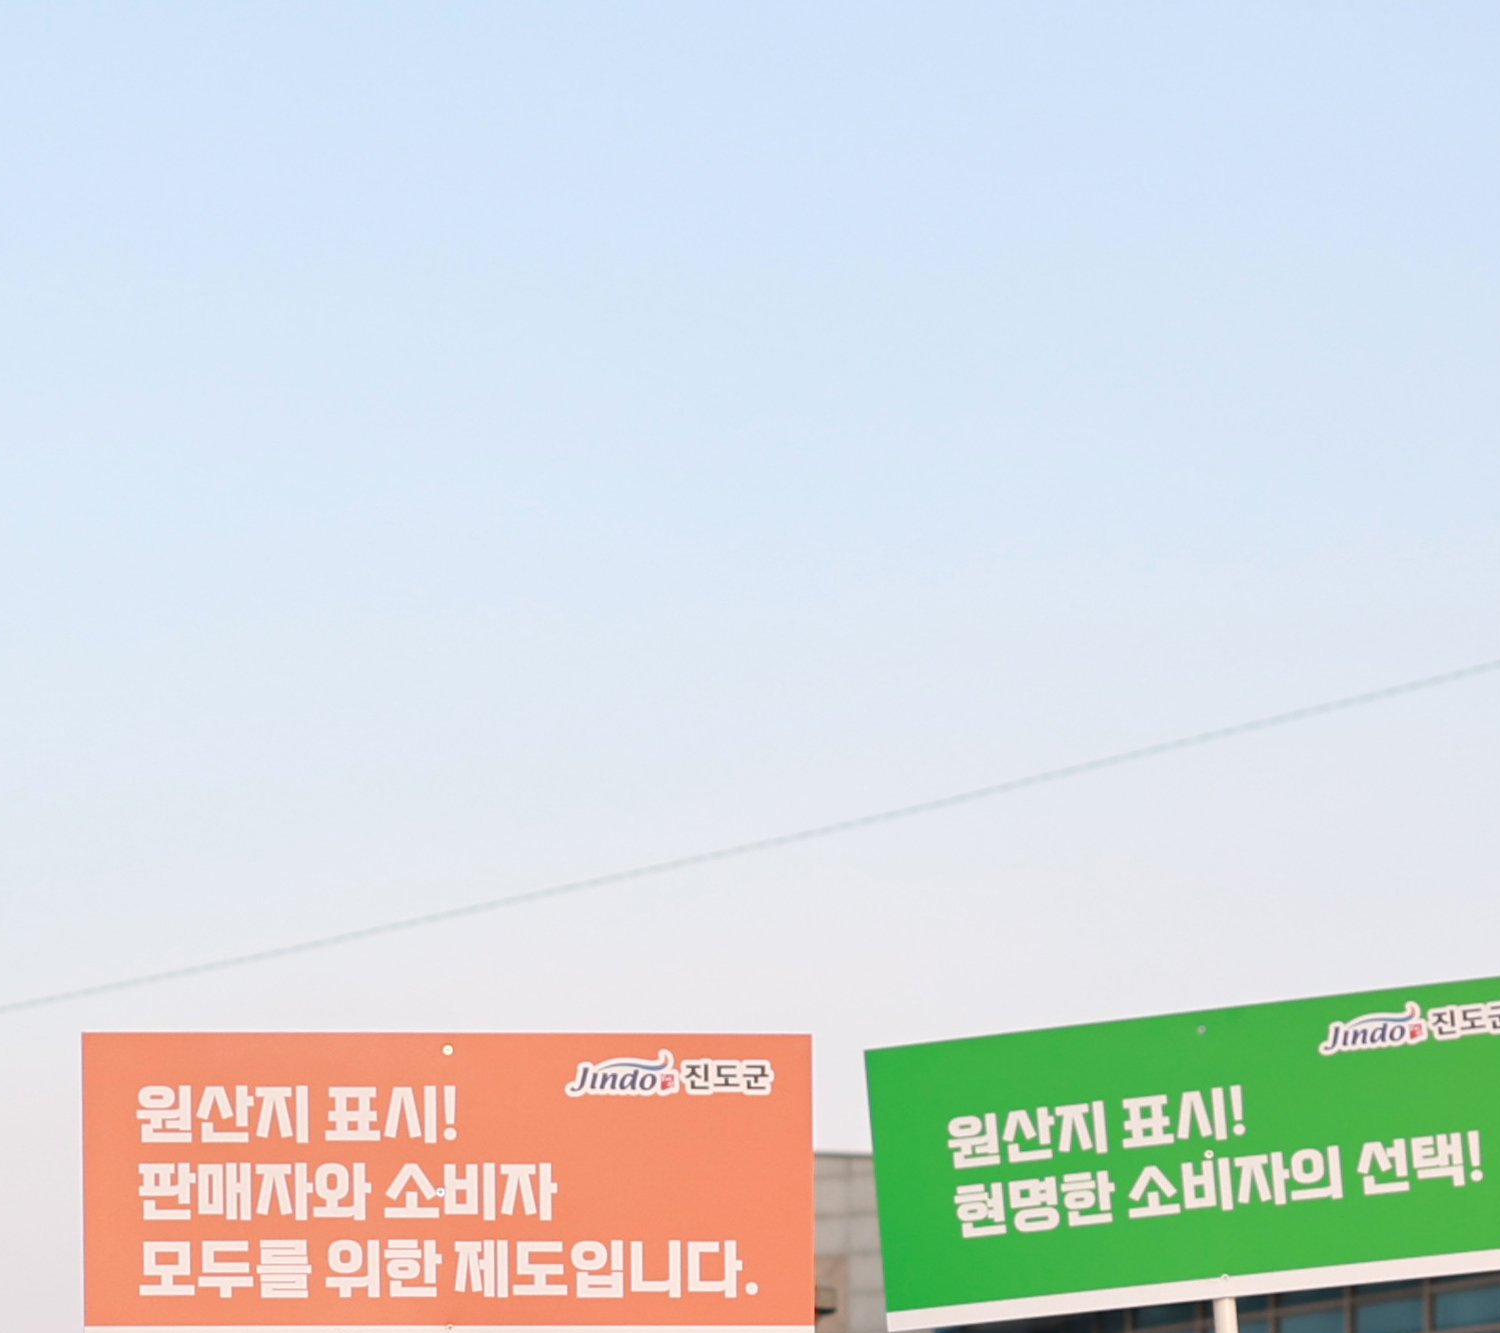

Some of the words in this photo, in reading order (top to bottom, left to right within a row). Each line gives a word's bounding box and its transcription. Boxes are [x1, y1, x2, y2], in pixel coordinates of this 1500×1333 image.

[683, 1062, 773, 1095] 진도군
[136, 1085, 309, 1145] 원산지
[325, 1085, 457, 1145] 표시!
[946, 1101, 1109, 1169] 원산지
[1121, 1084, 1246, 1149] 표시!
[137, 1162, 371, 1222] 판매자와
[383, 1162, 558, 1222] 소비자
[953, 1170, 1113, 1239] 현명한
[1127, 1148, 1343, 1220] 소비자의
[1356, 1129, 1484, 1197] 선택!
[138, 1240, 311, 1300] 모두를
[325, 1240, 443, 1300] 위한
[453, 1240, 760, 1300] 제도입니다.
